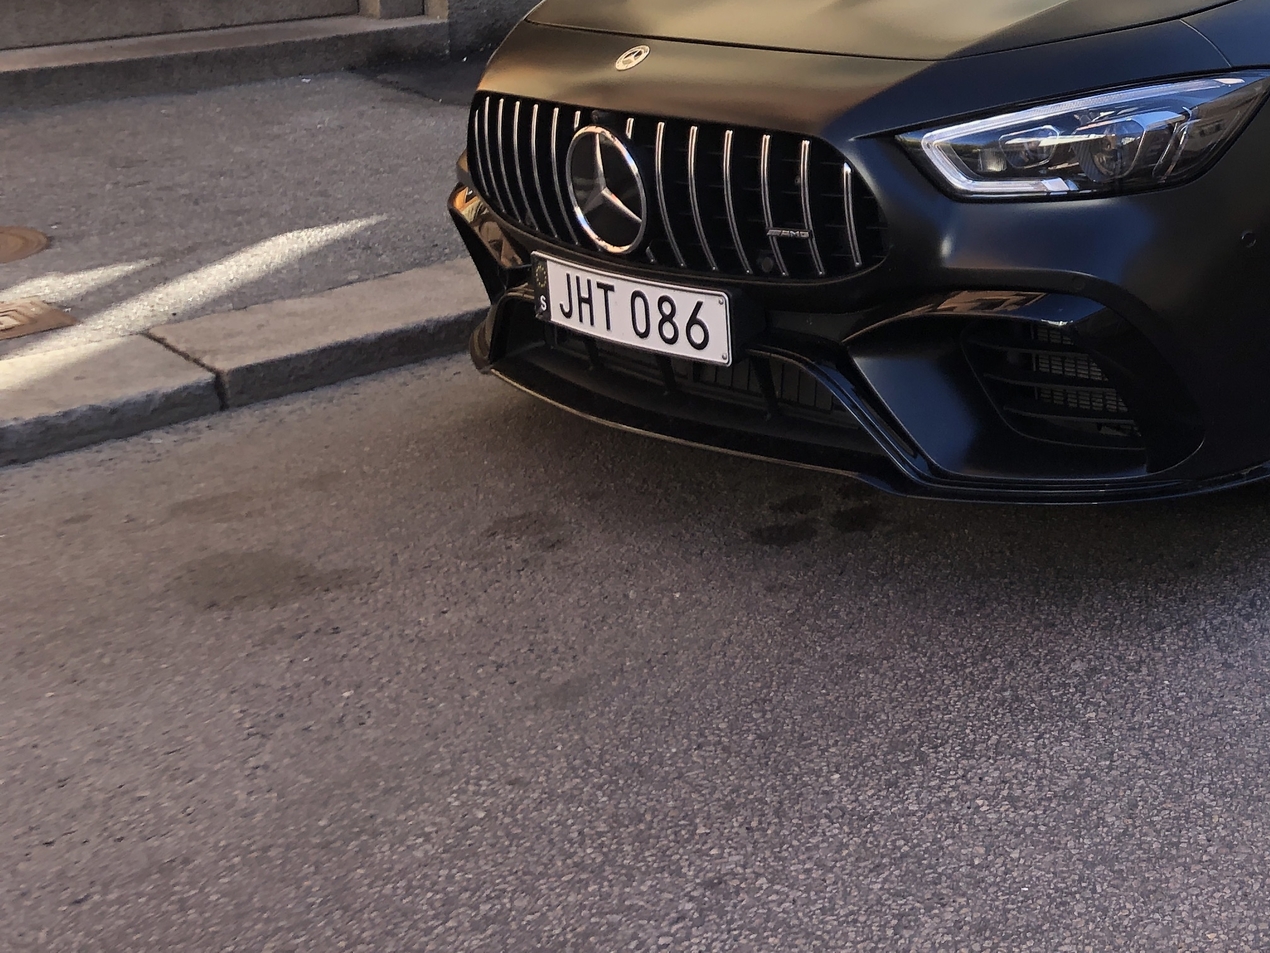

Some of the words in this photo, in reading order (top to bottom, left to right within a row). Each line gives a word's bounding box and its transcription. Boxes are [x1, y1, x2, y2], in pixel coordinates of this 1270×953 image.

[540, 295, 548, 312] S
[559, 273, 615, 332] JHT
[630, 289, 710, 351] 086
